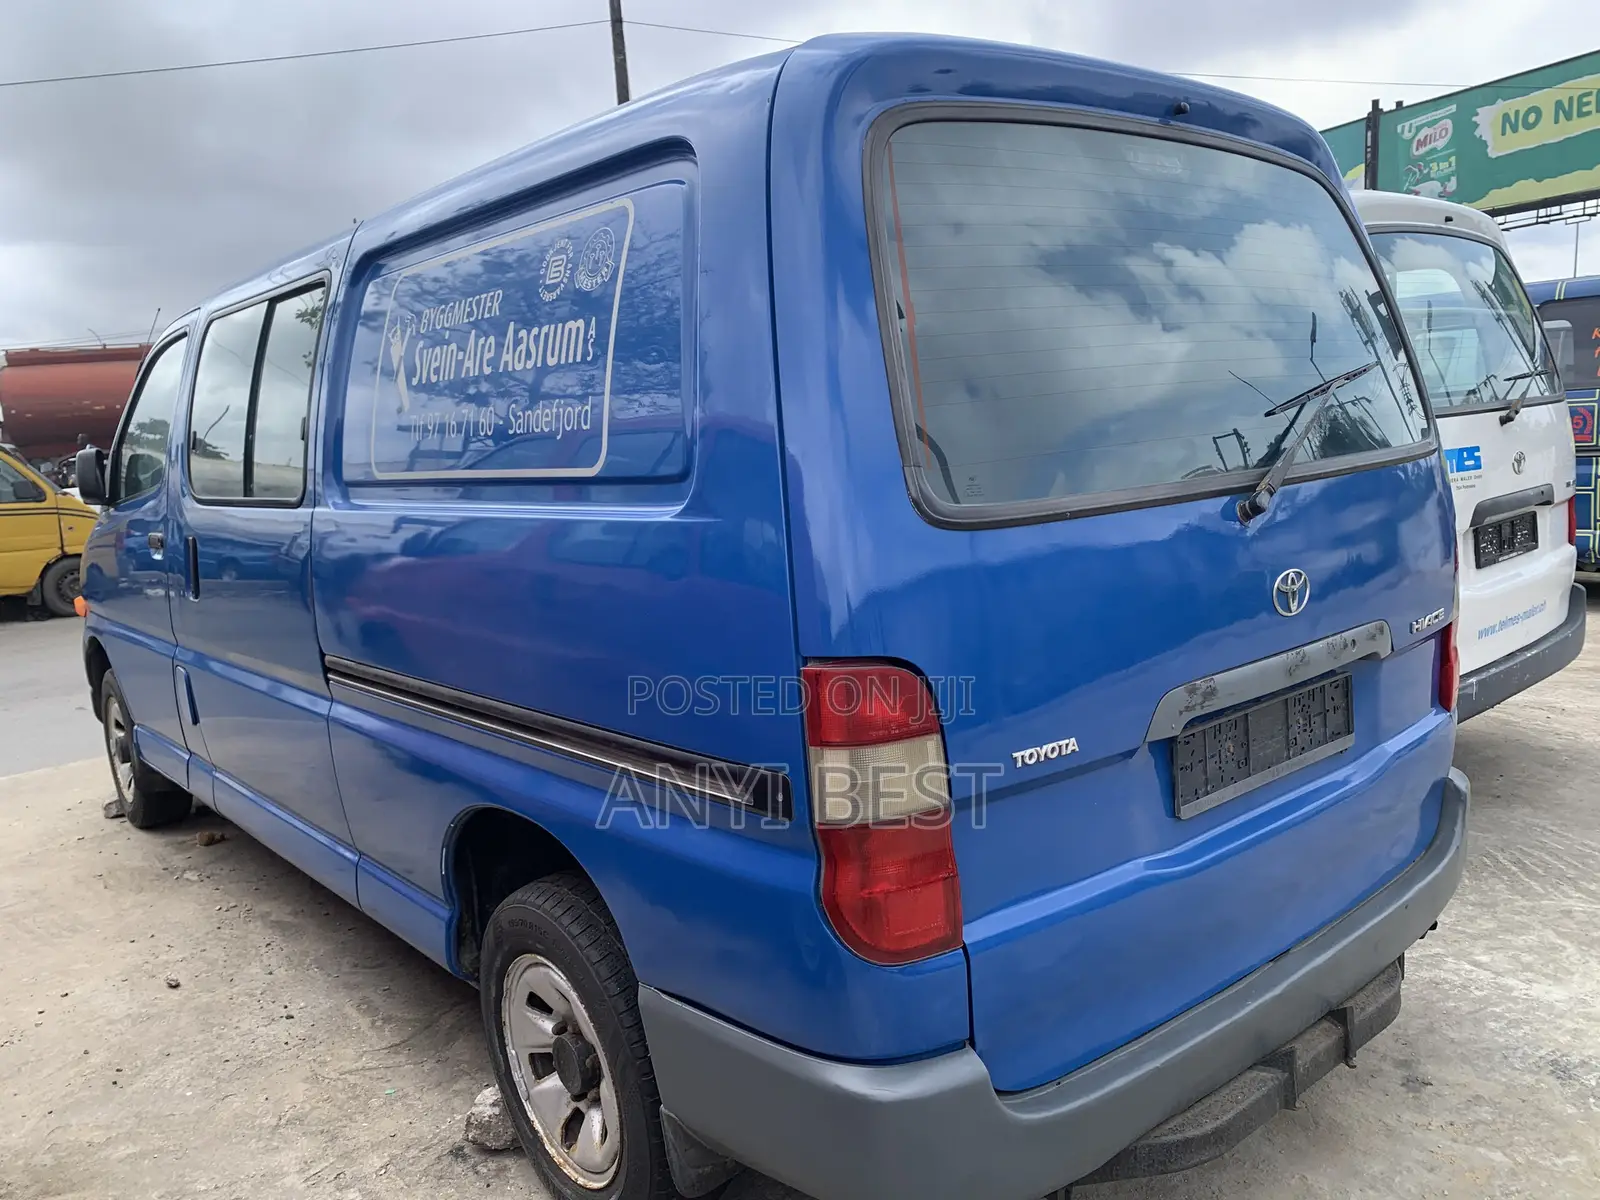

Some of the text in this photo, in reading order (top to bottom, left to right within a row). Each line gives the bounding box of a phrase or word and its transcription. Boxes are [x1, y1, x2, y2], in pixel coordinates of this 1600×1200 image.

[1501, 105, 1543, 136] NO
[1416, 127, 1449, 152] MILO
[420, 290, 503, 334] BYGGMESTER
[412, 329, 496, 386] Svein-Are
[499, 318, 585, 372] Aasrum
[427, 412, 440, 439] 97
[445, 412, 457, 438] 16
[461, 409, 474, 437] 71
[479, 406, 495, 436] 60
[508, 396, 592, 440] Sandefjord
[1410, 607, 1445, 634] HIACE
[1011, 737, 1079, 768] TOYOTA
